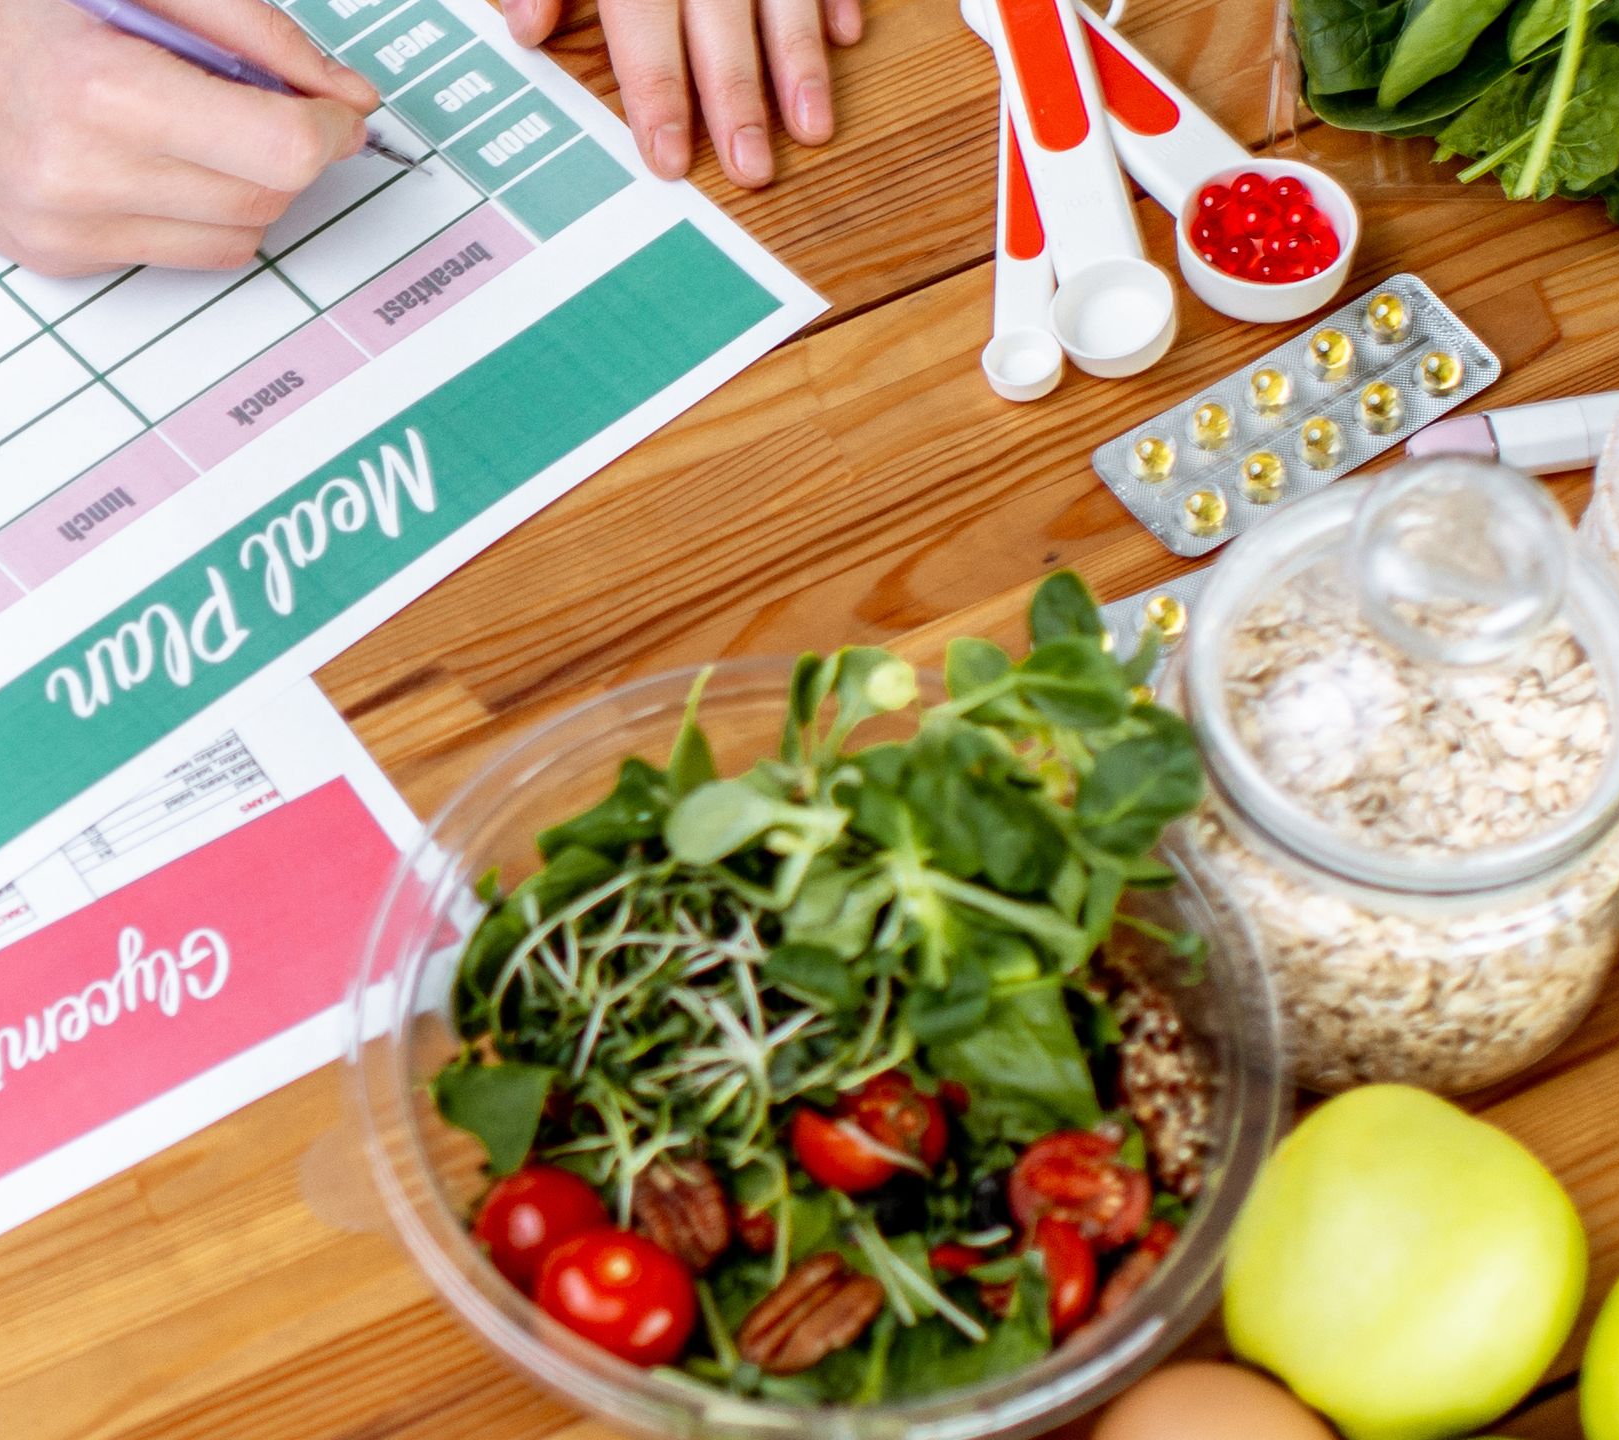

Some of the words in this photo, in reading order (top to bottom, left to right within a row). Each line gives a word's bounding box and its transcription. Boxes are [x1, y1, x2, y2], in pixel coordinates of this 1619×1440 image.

[374, 20, 445, 73] wed
[434, 70, 493, 111] tue
[478, 112, 551, 166] mon
[373, 241, 492, 324] breakfast
[227, 370, 304, 425] snack
[57, 486, 135, 541] lunch
[239, 427, 436, 615] Meal
[45, 566, 249, 718] Plan
